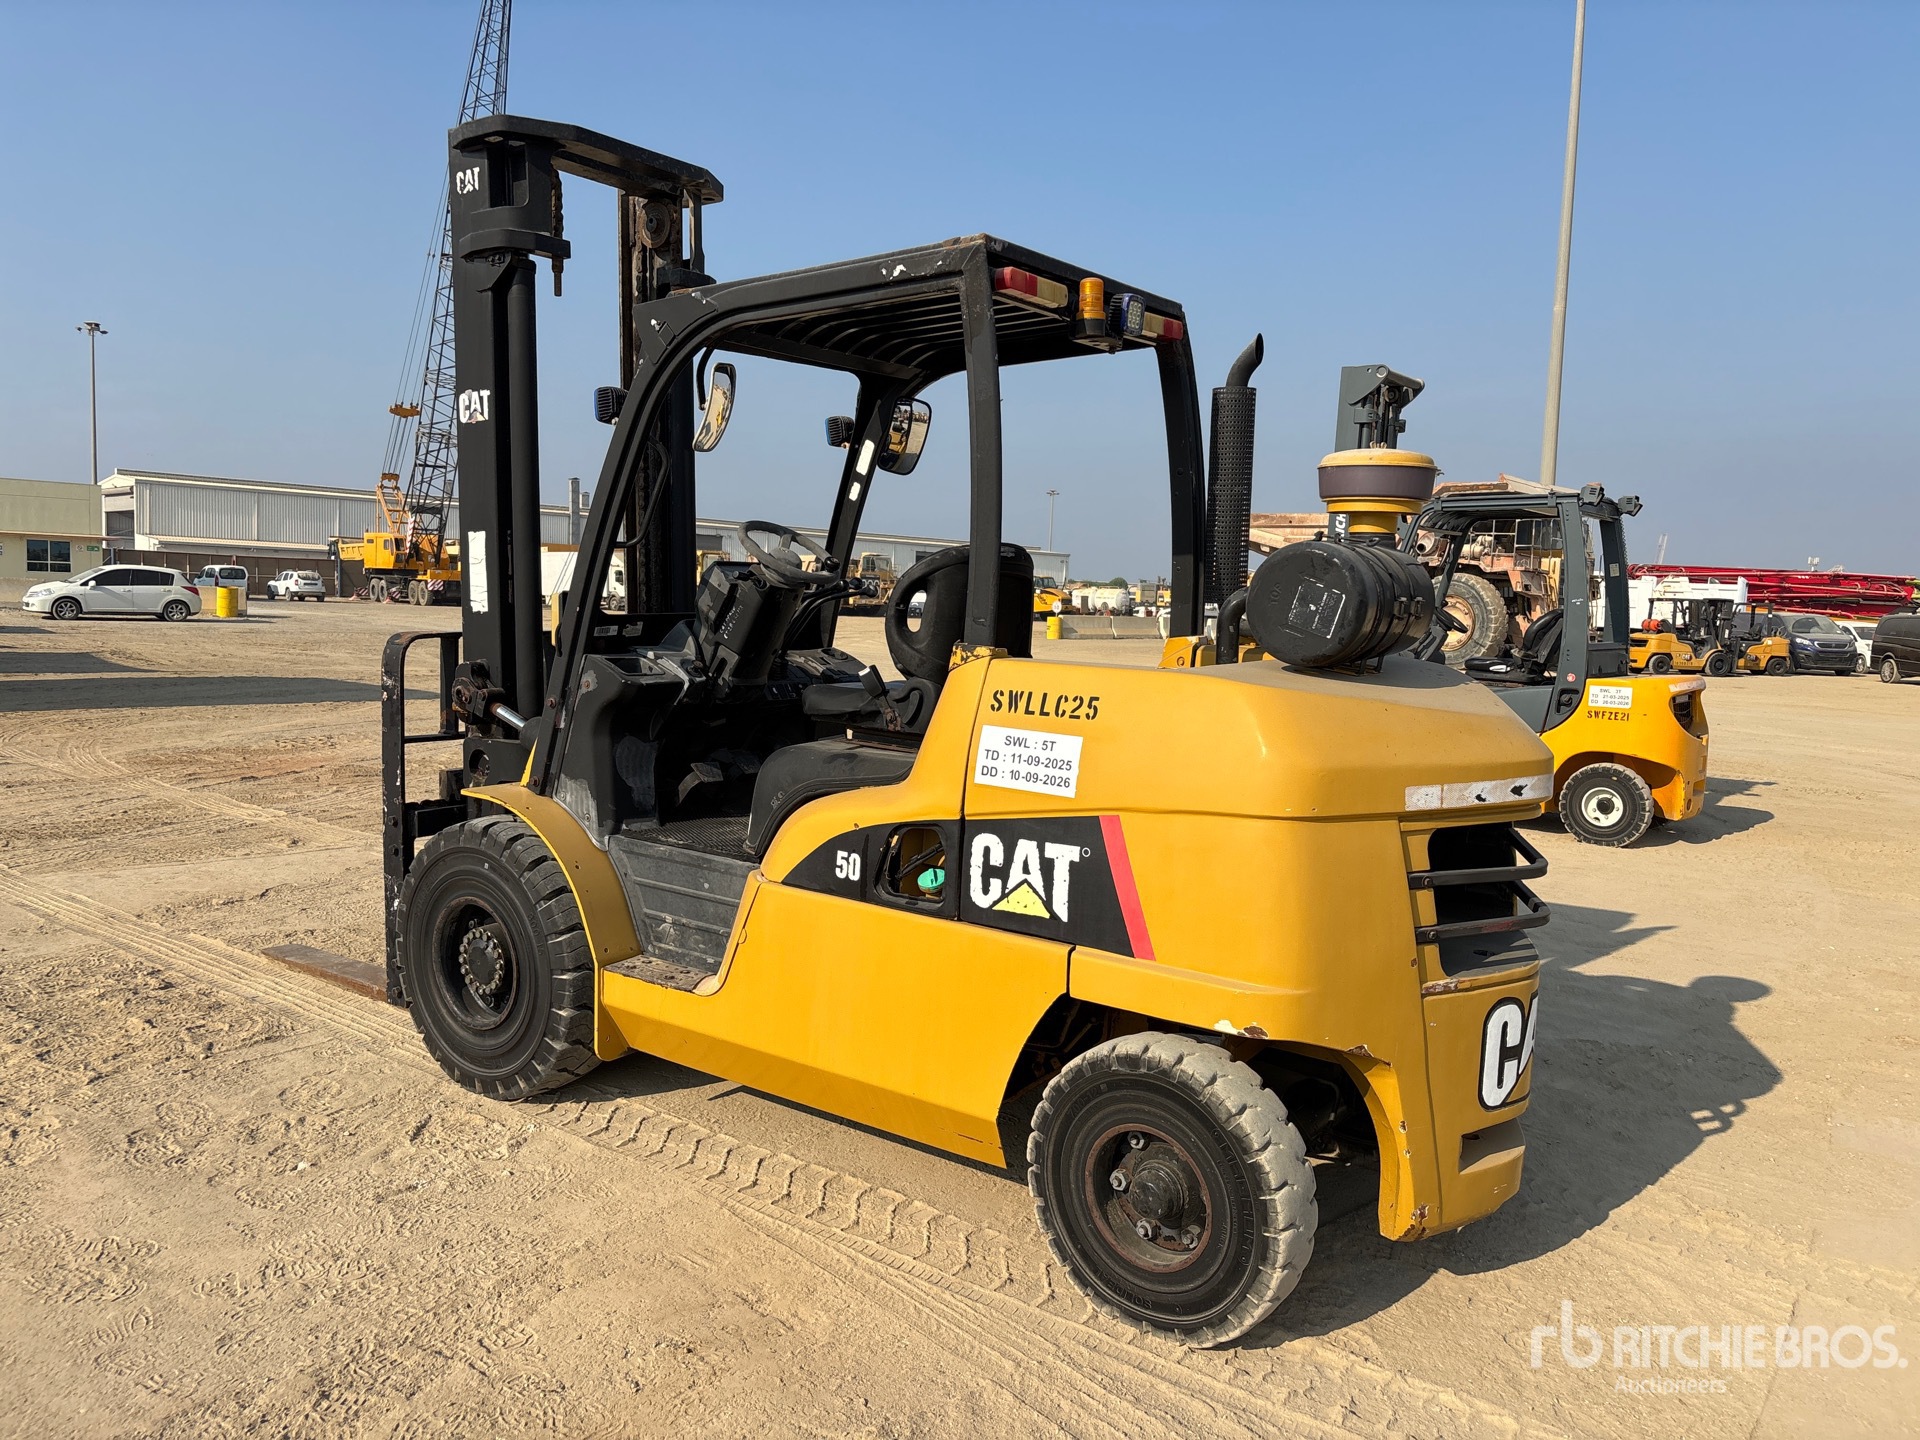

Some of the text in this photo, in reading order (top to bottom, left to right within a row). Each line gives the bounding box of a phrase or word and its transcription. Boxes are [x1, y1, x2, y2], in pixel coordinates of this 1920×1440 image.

[455, 166, 480, 195] CAT
[458, 389, 491, 424] CAT
[990, 689, 1100, 720] SWLLC25
[1004, 735, 1031, 749] SWL
[1041, 740, 1057, 752] 5T
[984, 749, 1000, 761] TD
[1010, 753, 1073, 771] 11-09-2025
[981, 765, 998, 778] DD
[1009, 769, 1071, 788] 10-09-2026
[835, 849, 862, 881] 50
[969, 832, 1081, 923] CAT
